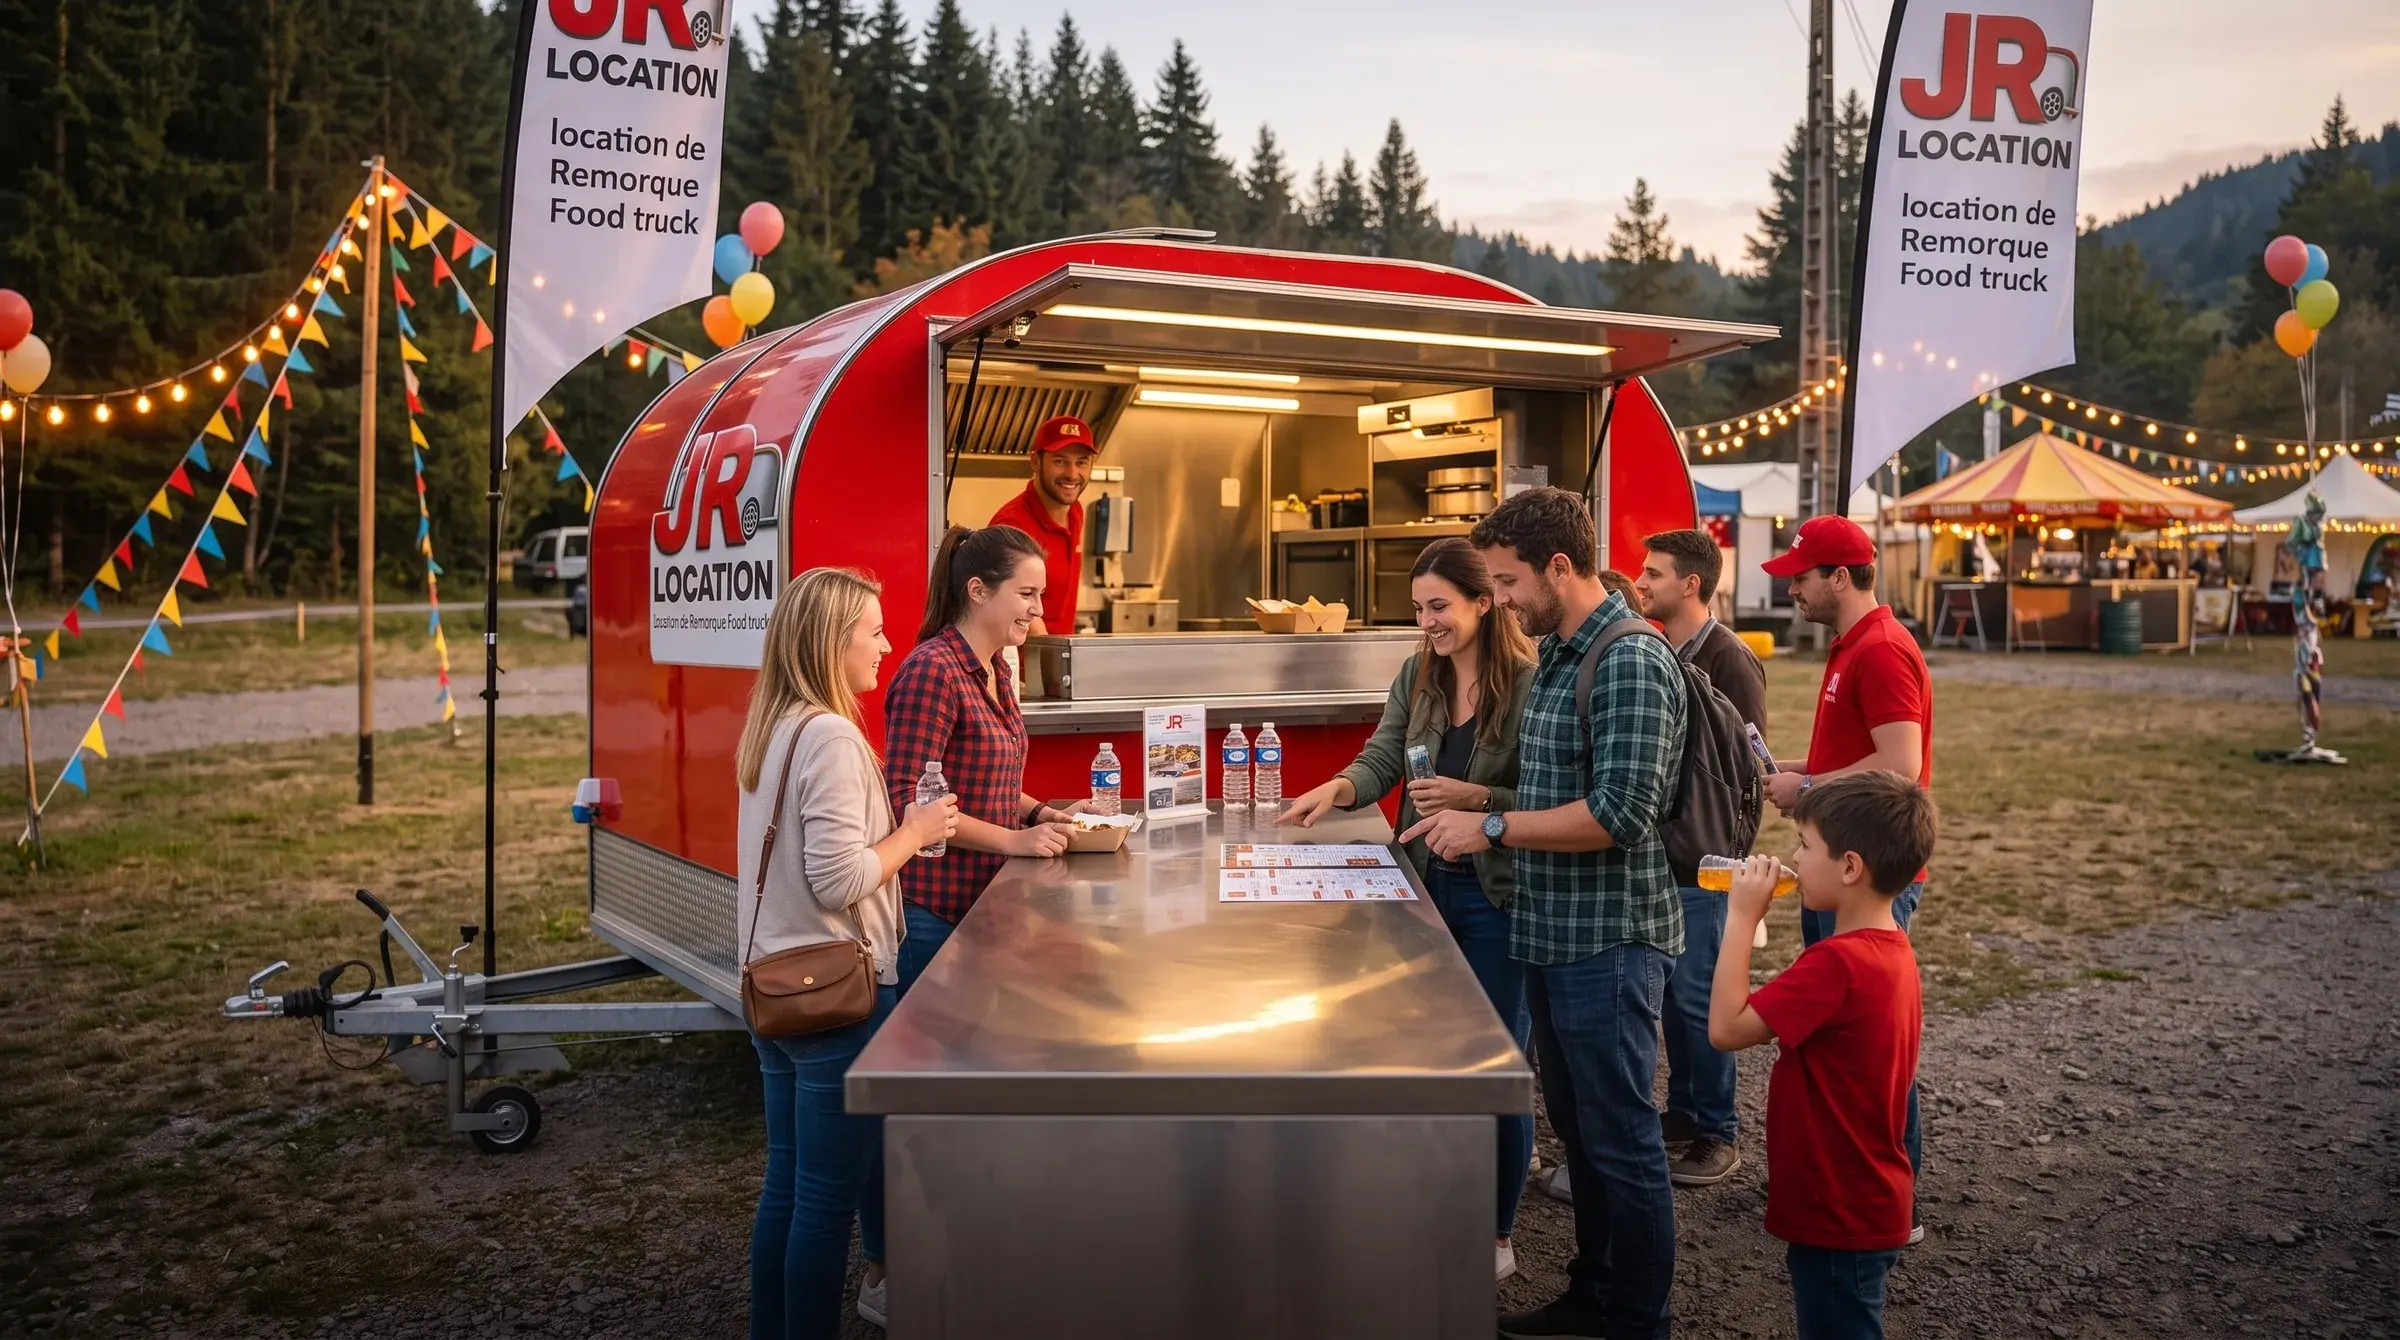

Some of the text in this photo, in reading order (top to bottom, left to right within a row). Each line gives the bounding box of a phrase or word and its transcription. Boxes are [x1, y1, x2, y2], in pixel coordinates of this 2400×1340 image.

[546, 47, 718, 99] LOCATION
[1900, 12, 2048, 124] JR
[551, 117, 705, 161] location de
[1898, 130, 2072, 169] LOCATION
[550, 158, 699, 201] Remorque
[550, 198, 699, 235] Food truck
[1902, 192, 2056, 225] location de
[1901, 228, 2048, 263] Remorque
[1901, 262, 2048, 292] Food truck
[653, 425, 757, 556] JR
[654, 559, 773, 603] LOCATION
[653, 613, 770, 633] Location de Remorque Food truck
[1166, 715, 1182, 729] JR
